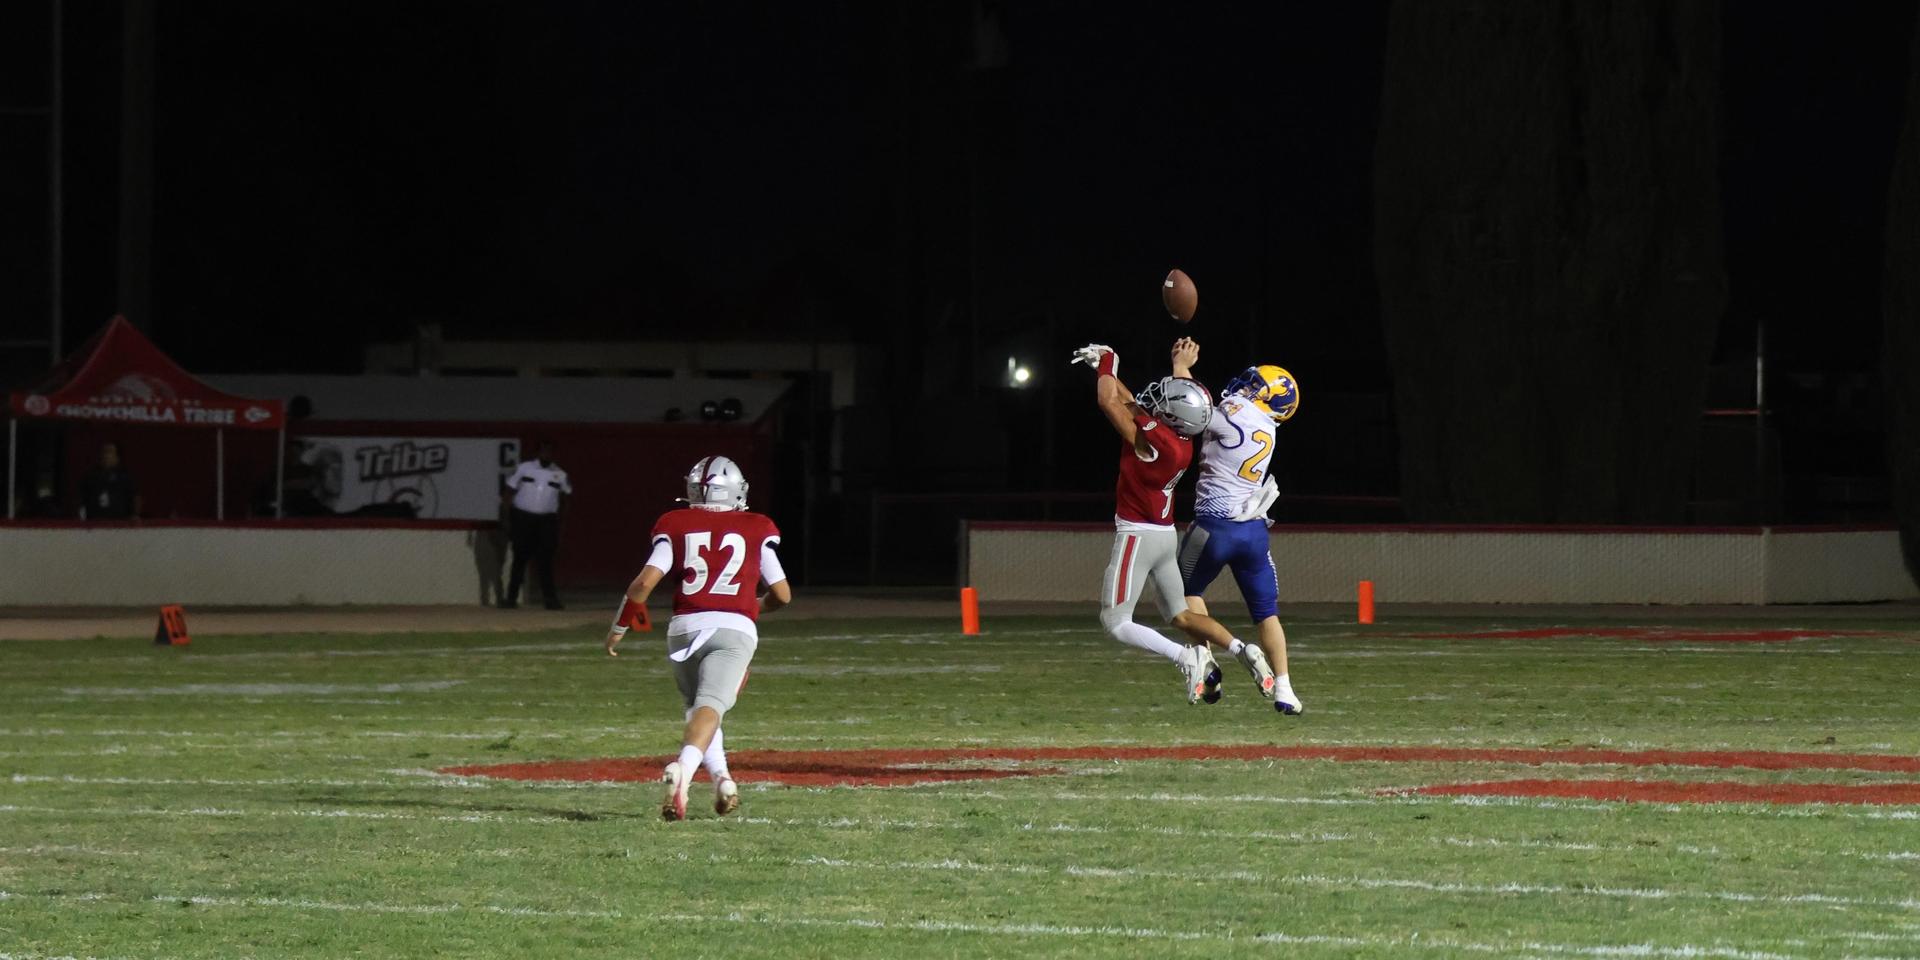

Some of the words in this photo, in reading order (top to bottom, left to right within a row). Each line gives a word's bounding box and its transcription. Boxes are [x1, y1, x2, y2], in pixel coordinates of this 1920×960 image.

[57, 405, 176, 422] CHOWCHILLA
[184, 408, 235, 424] TRIBE
[356, 441, 449, 482] Tribe
[1237, 429, 1274, 484] 2
[681, 531, 747, 596] 52
